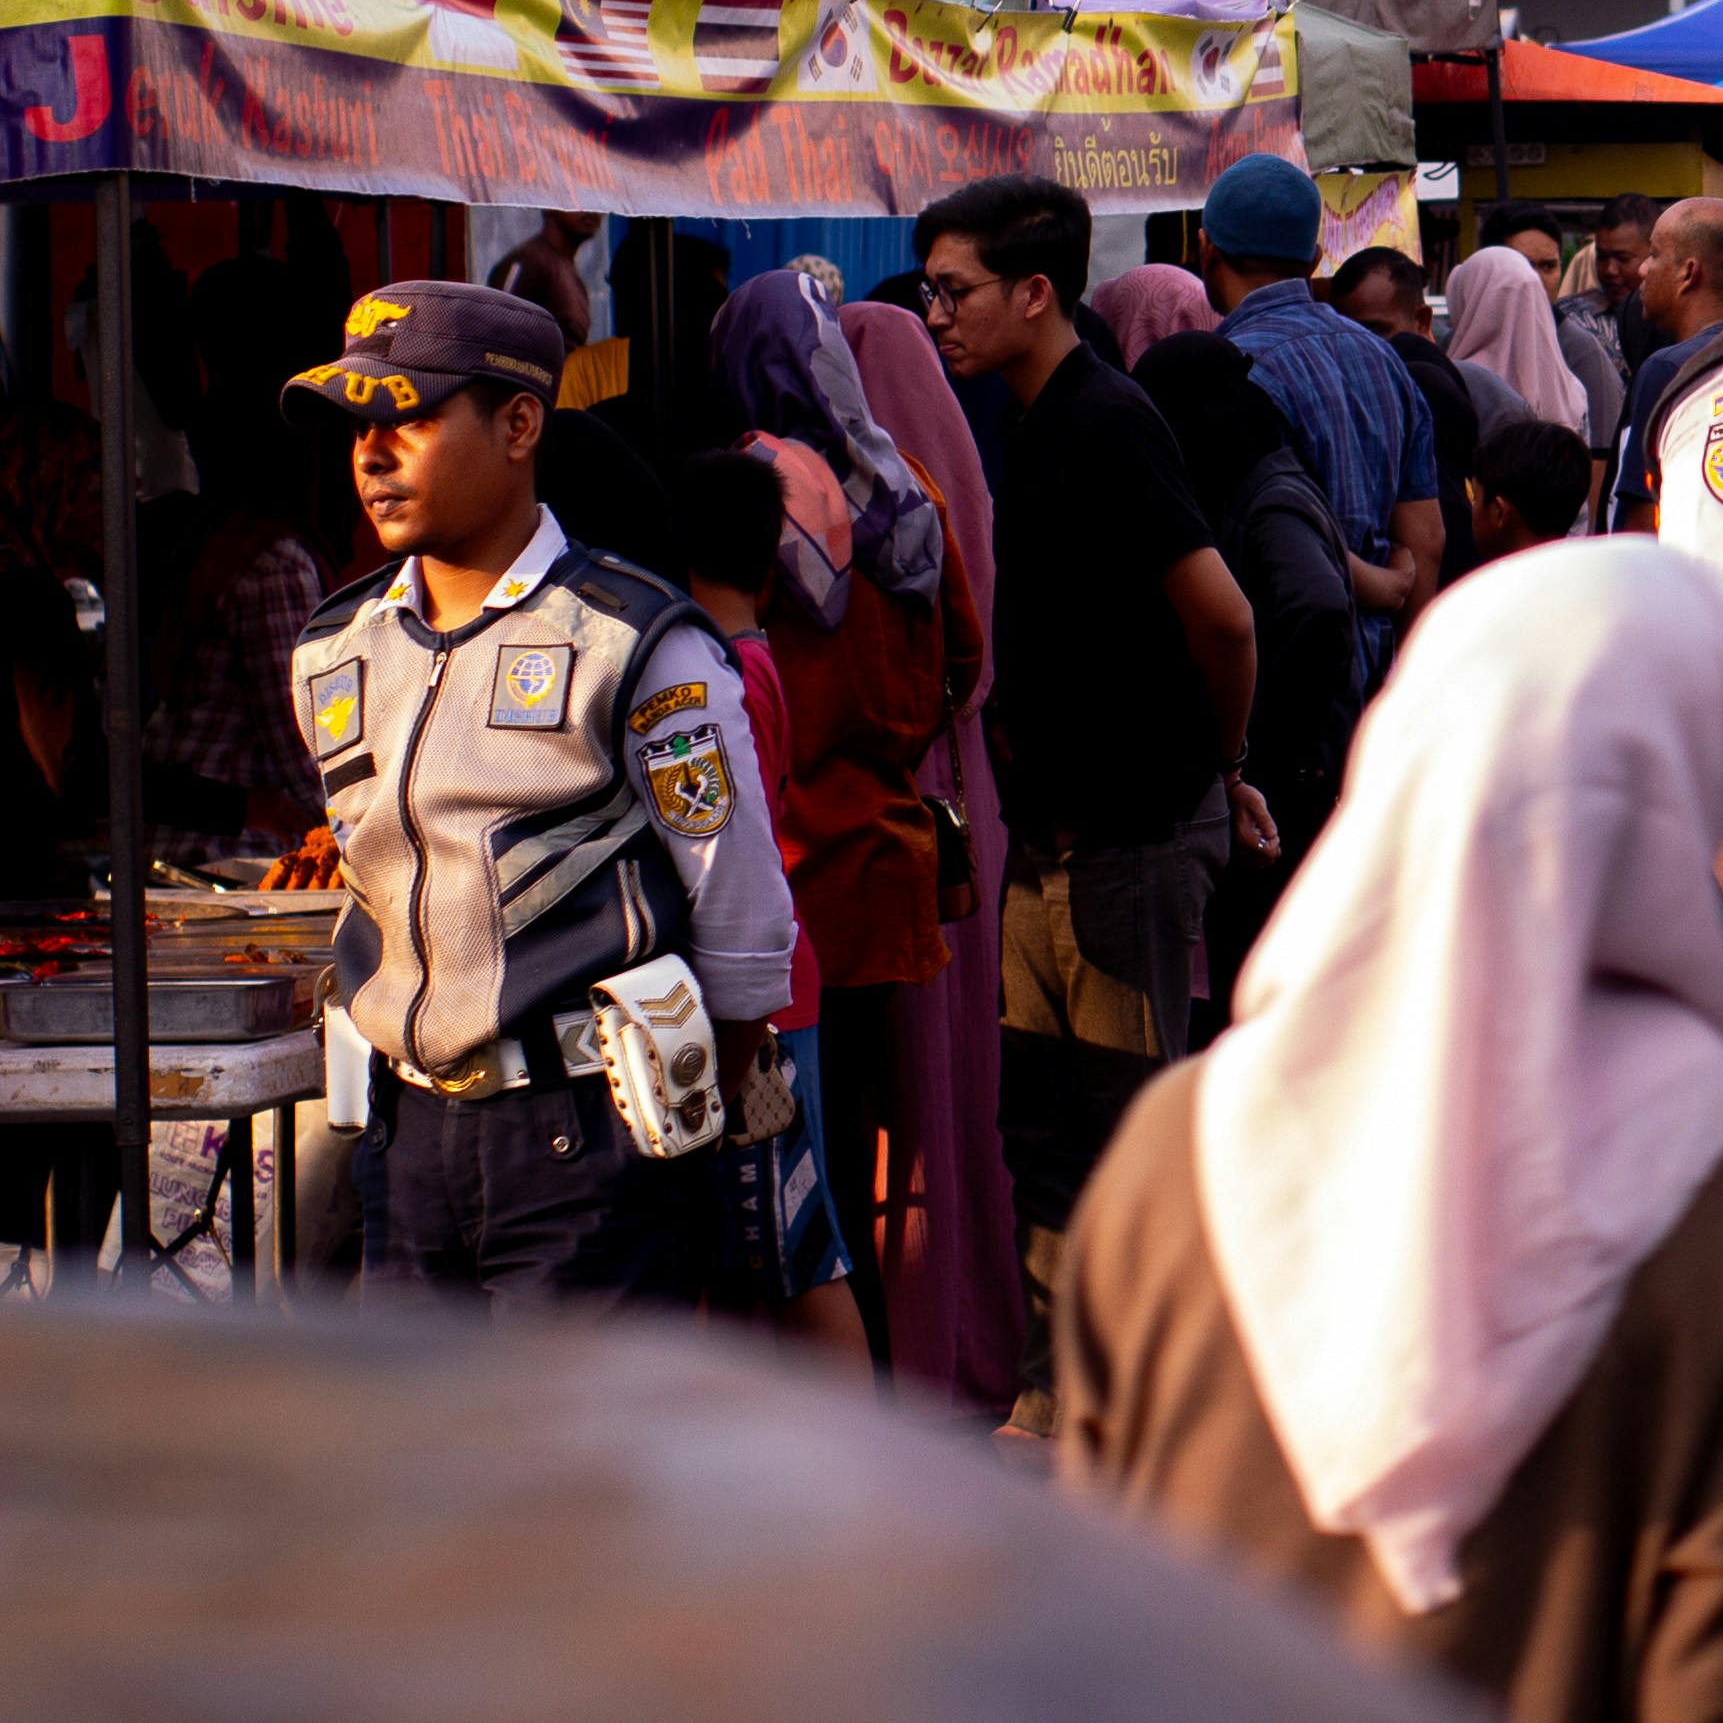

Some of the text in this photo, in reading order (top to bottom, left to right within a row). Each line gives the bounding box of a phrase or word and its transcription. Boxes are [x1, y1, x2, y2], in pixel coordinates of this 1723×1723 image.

[424, 78, 502, 179] Thai
[705, 102, 856, 208] Pad Thai
[638, 686, 692, 718] PEMKO
